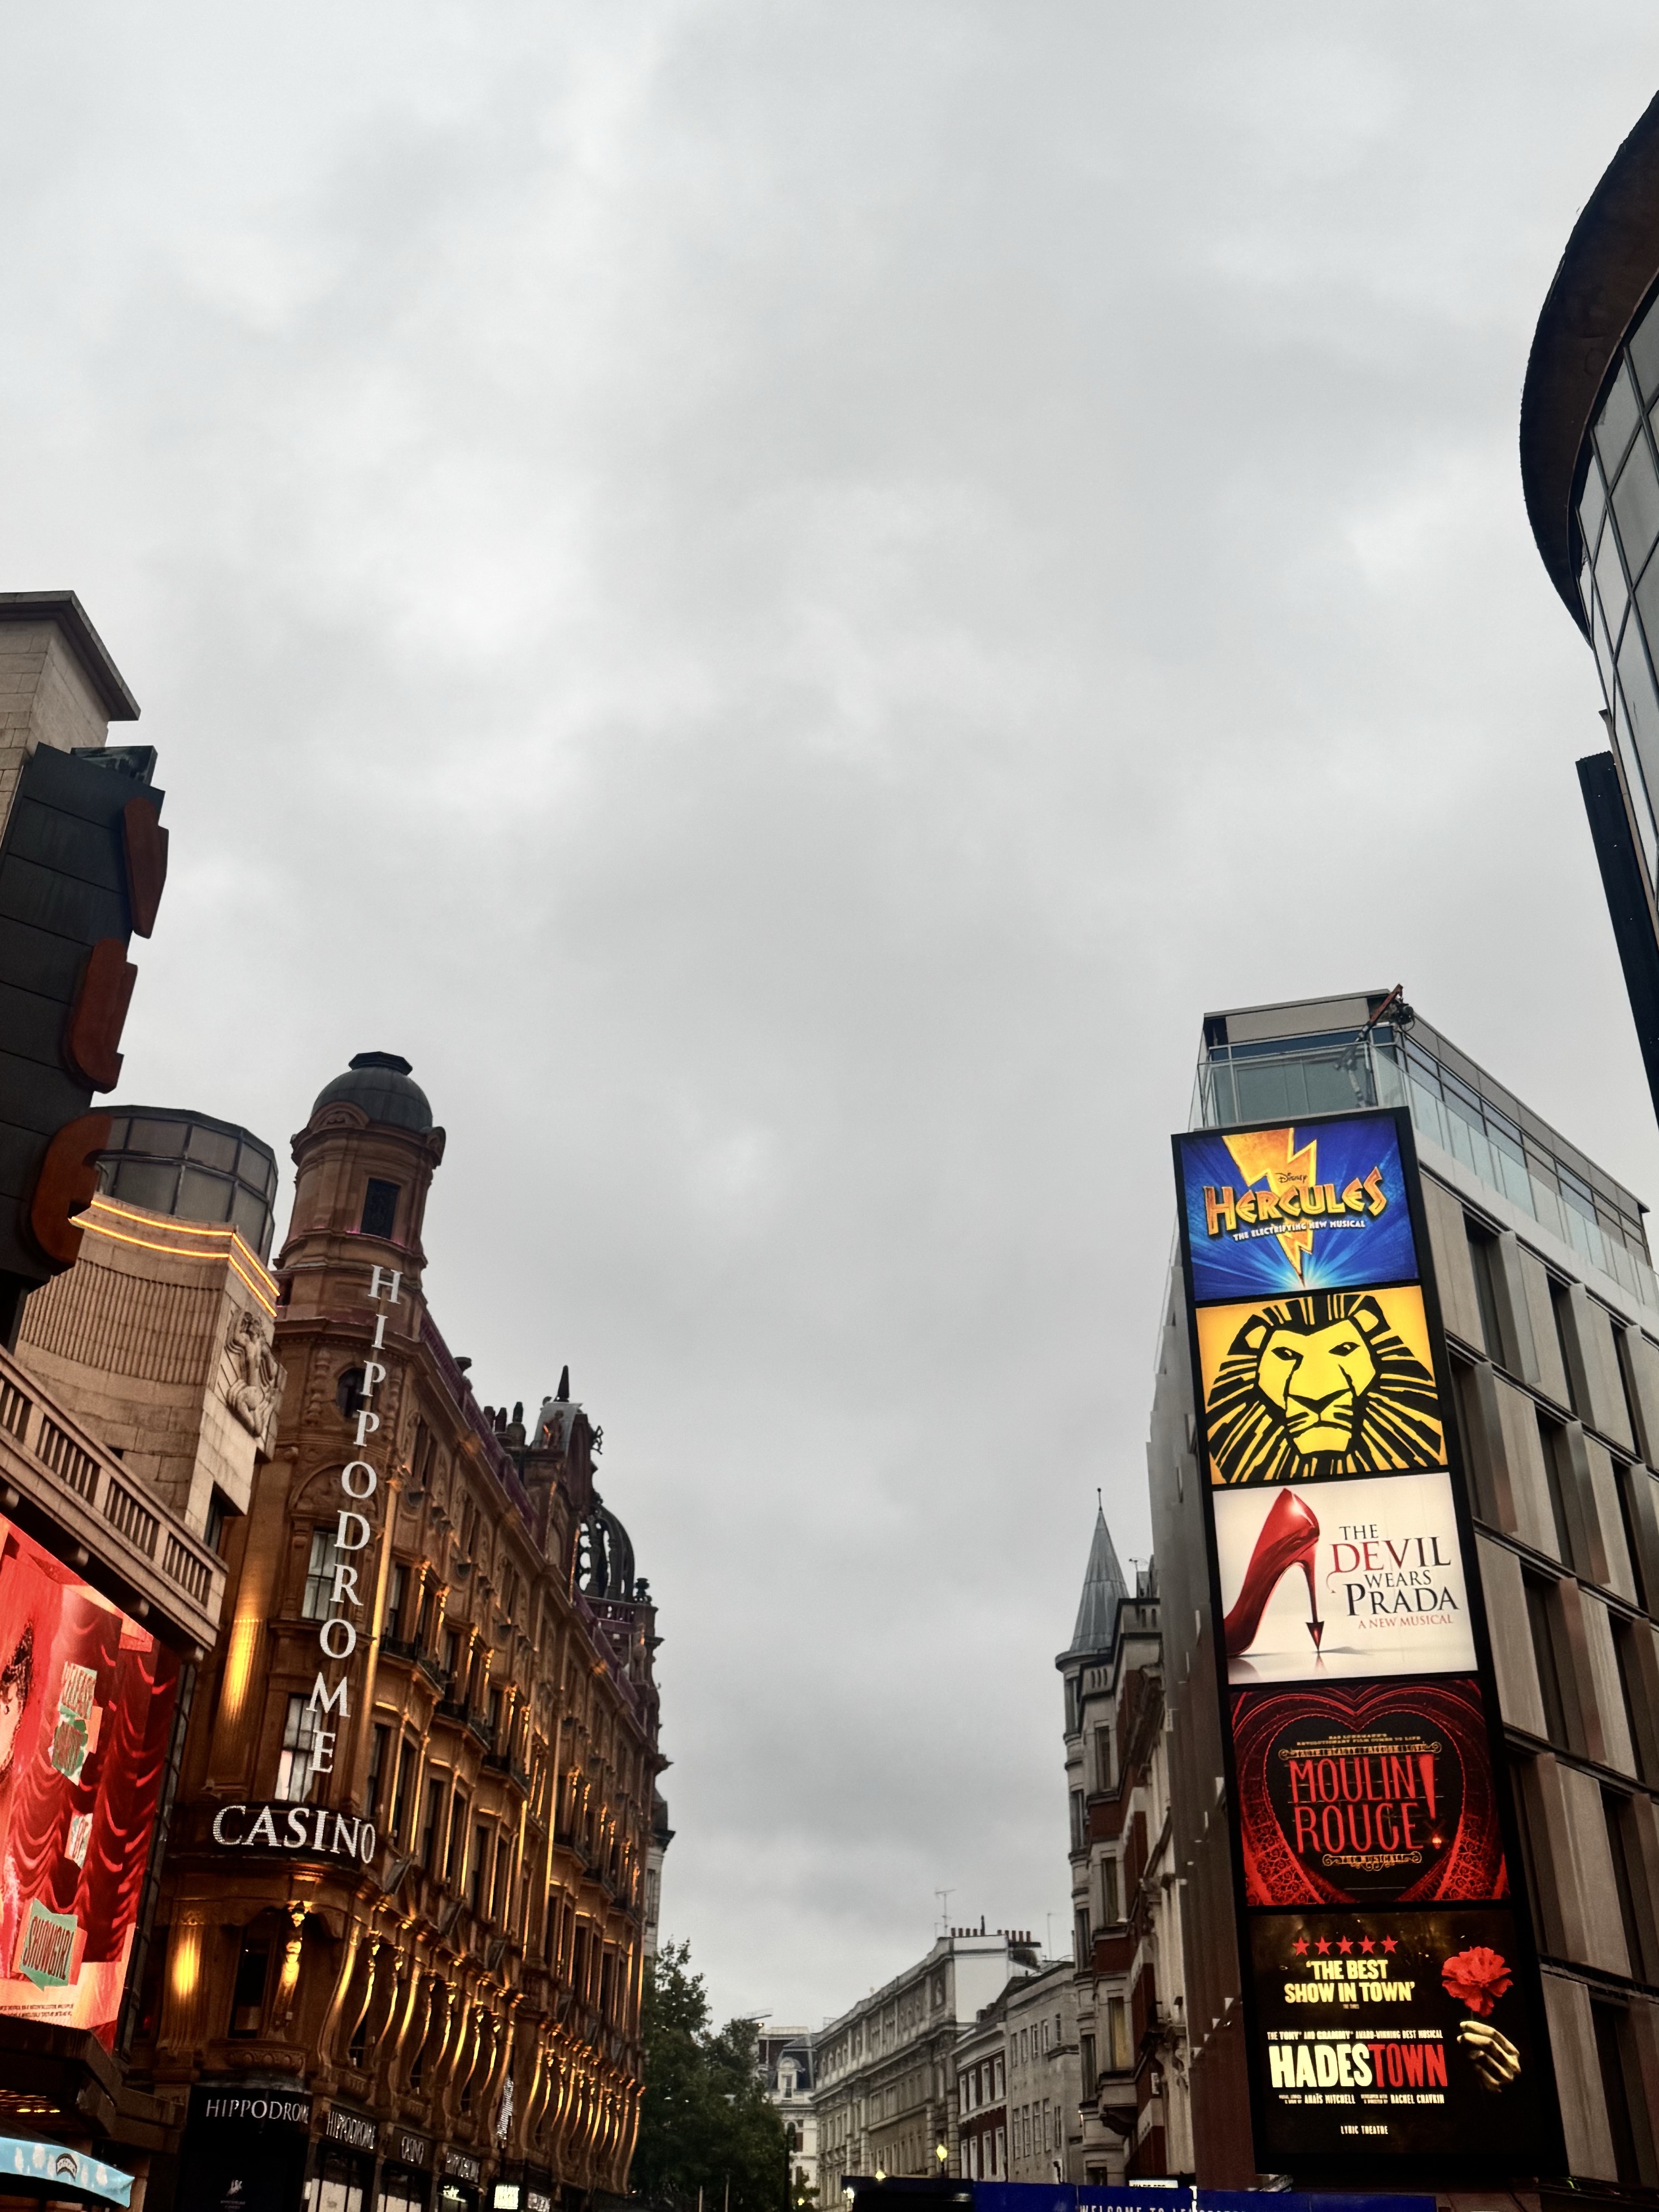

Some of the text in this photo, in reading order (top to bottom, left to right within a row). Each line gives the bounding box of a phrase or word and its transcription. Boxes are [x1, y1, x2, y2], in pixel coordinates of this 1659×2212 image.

[1275, 1171, 1307, 1184] Disney
[1203, 1166, 1387, 1235] HERCULES
[1233, 1231, 1249, 1241] THE
[1251, 1222, 1307, 1238] ELECTRIFYING
[1309, 1221, 1327, 1229] NEW
[307, 1264, 404, 1774] HIPPODROME
[1339, 1524, 1378, 1540] THE
[1330, 1536, 1451, 1573] DEVIL
[1364, 1570, 1432, 1588] WEARS
[1346, 1583, 1460, 1616] PRADA
[1358, 1614, 1454, 1629] A NEW MUSICAL
[1289, 1755, 1416, 1803] MOULIN
[212, 1805, 377, 1865] CASINO
[1347, 1959, 1388, 1979] BEST
[1284, 1983, 1334, 2003] SHOW
[1338, 1983, 1357, 2002] IN
[1268, 2031, 1279, 2040] THE
[1403, 2030, 1417, 2039] BEST
[1417, 2030, 1443, 2039] MUSICAL
[1268, 2043, 1448, 2088] HADESTOWN
[1325, 2094, 1356, 2104] MITCHELL
[1390, 2094, 1415, 2104] RACHEL
[1340, 2125, 1389, 2134] LYRIC THEATRE
